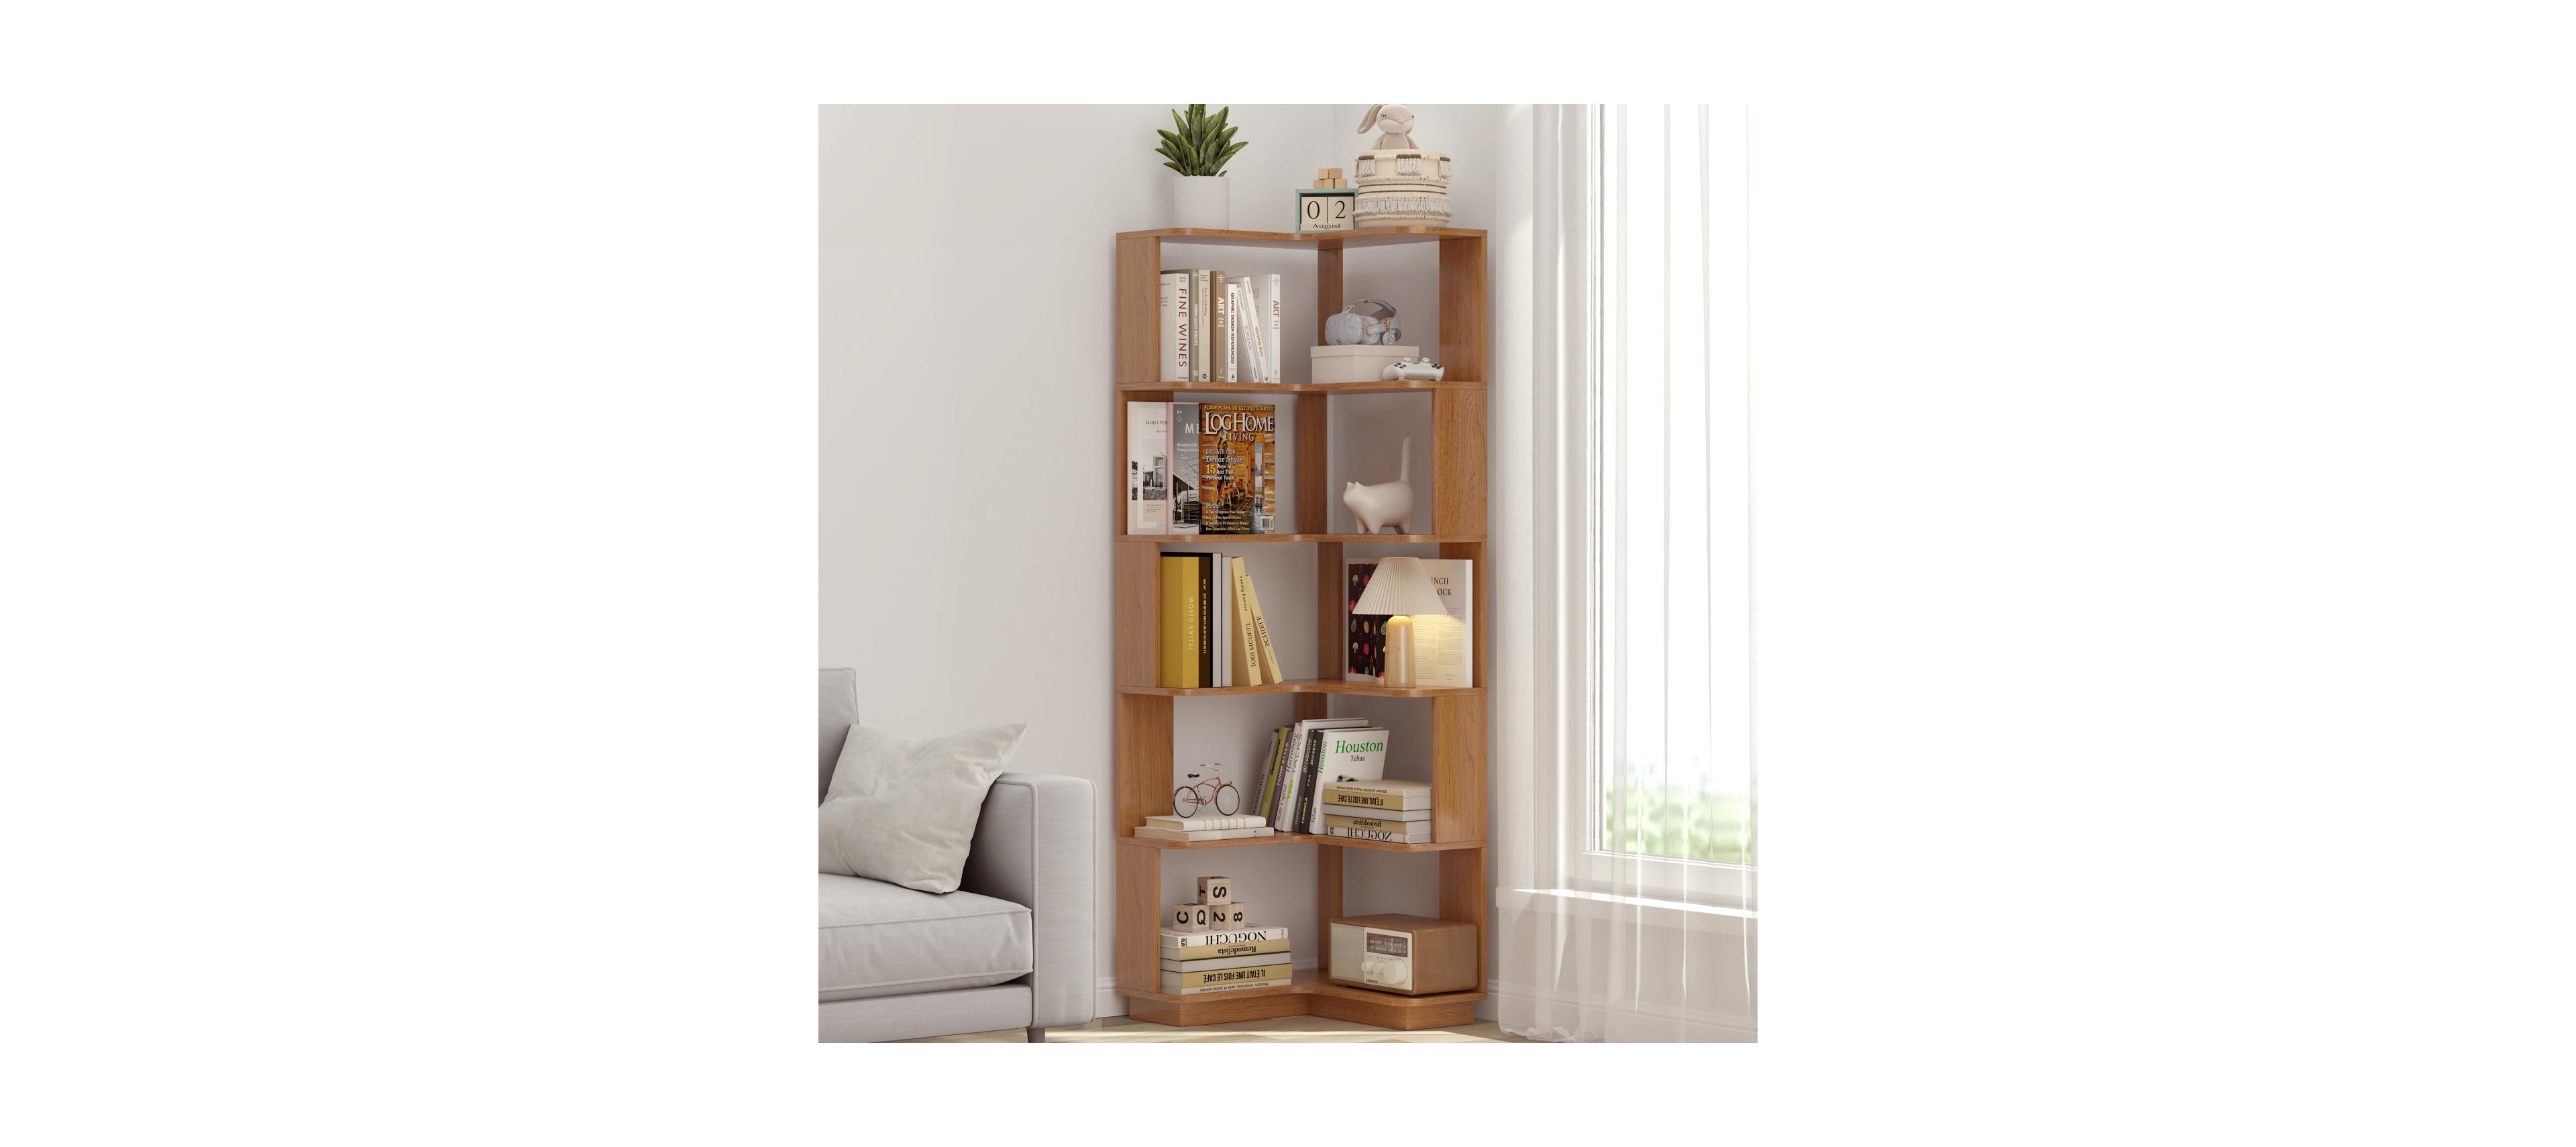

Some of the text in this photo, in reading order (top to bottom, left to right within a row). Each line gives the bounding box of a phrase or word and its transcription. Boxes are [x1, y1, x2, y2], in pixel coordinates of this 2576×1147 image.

[1307, 201, 1346, 219] 0 2
[1179, 288, 1187, 317] FINE
[1179, 324, 1187, 368] WINES
[1204, 412, 1274, 435] LOG HOME
[1225, 433, 1254, 441] LIVING
[1205, 464, 1216, 474] 15
[1287, 734, 1299, 772] Harrisburg
[1335, 741, 1383, 753] Houston
[1293, 734, 1303, 773] TALKS
[1303, 739, 1312, 773] Brisbane
[1318, 742, 1327, 773] Houston
[1199, 885, 1205, 897] T
[1213, 886, 1226, 898] S
[1177, 911, 1189, 924] C
[1197, 910, 1205, 925] Q
[1214, 912, 1225, 922] 2
[1234, 912, 1242, 922] 8
[1205, 931, 1267, 945] NOGUCHI
[1218, 946, 1256, 955] Remodelista
[1203, 975, 1216, 984] CAFÉ
[1217, 973, 1222, 981] LE
[1224, 973, 1234, 981] FOIS
[1236, 971, 1245, 979] UNE
[1246, 970, 1260, 979] ÉTAIT
